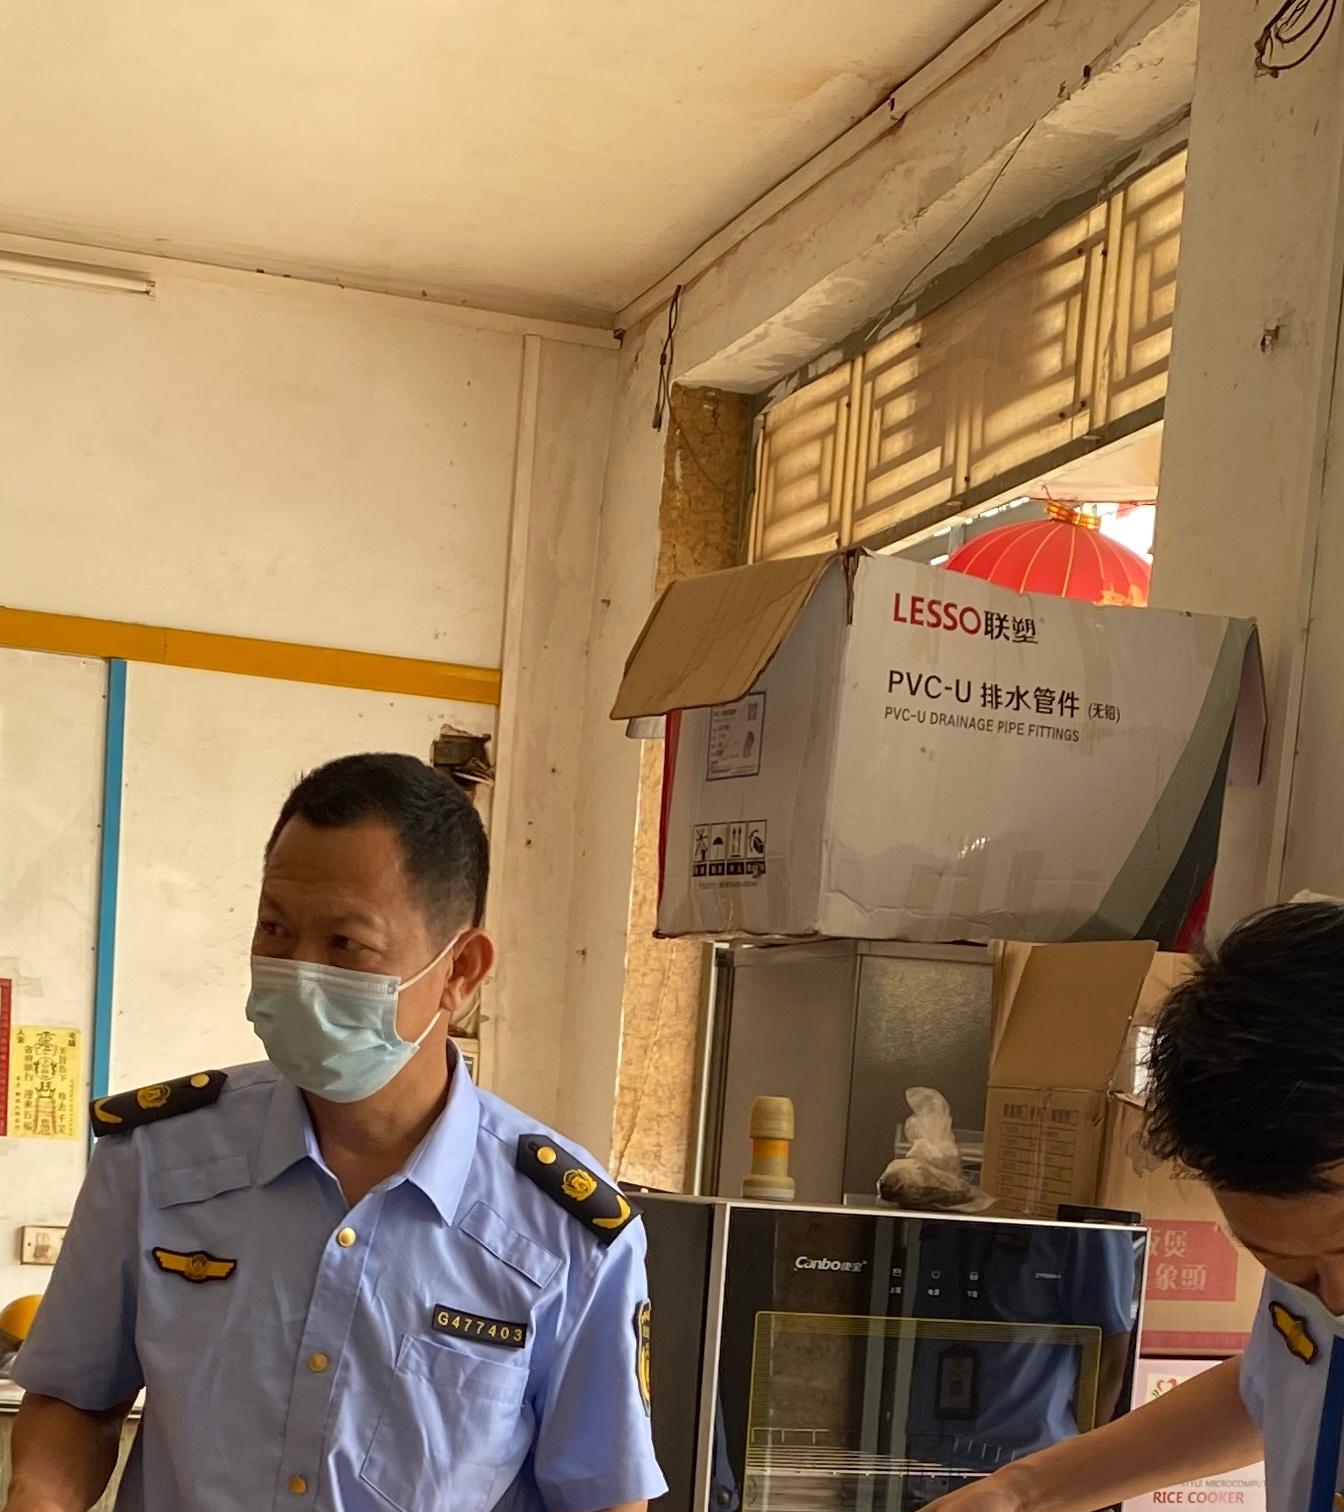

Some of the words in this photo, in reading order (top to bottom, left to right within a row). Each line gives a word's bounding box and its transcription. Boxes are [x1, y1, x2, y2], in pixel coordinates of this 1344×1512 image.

[887, 670, 972, 704] PVC-U
[980, 681, 1081, 718] 排水管件
[884, 706, 927, 724] PVC-U
[929, 711, 994, 733] DRAINAGE
[996, 721, 1025, 737] PIPE
[1027, 723, 1080, 743] FITTINGS
[437, 1311, 523, 1342] G477403
[1153, 1491, 1183, 1504] RICE
[1188, 1491, 1244, 1504] COOKER
